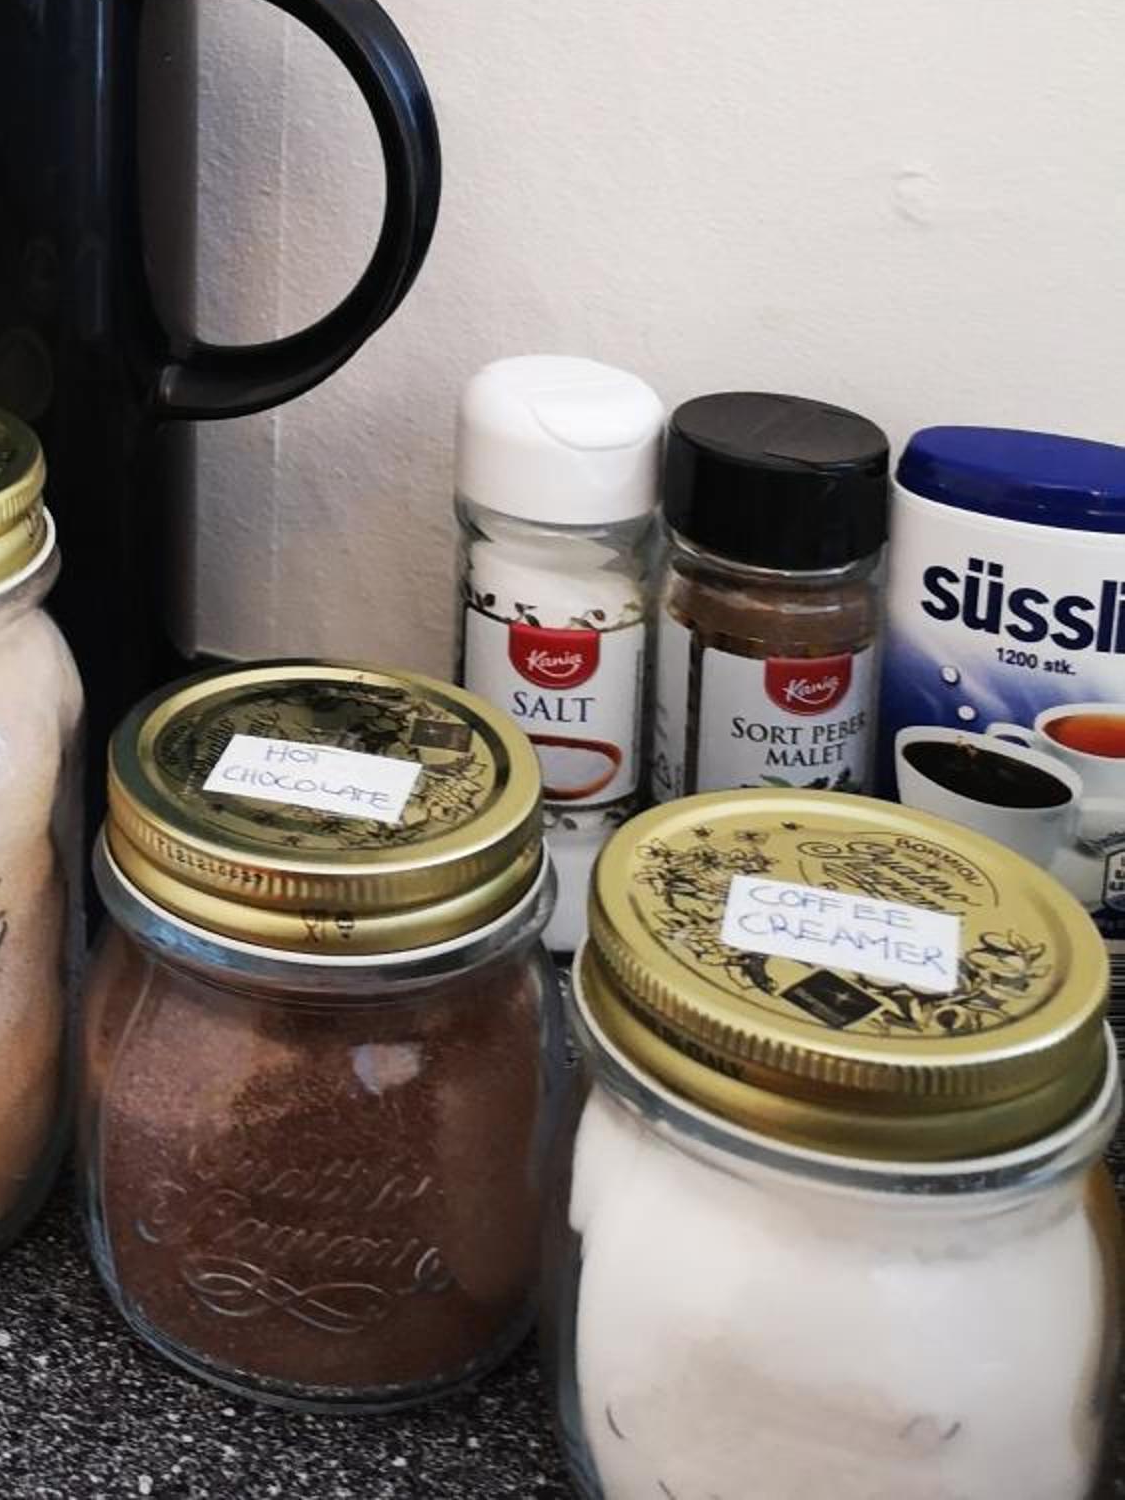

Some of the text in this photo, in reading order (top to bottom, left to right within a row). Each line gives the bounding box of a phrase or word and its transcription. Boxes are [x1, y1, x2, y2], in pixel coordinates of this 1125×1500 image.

[995, 647, 1077, 677] 1200 stk.
[511, 690, 596, 723] SALT
[731, 716, 804, 745] SORT
[264, 744, 345, 765] HOT
[765, 741, 845, 767] MALET
[222, 764, 396, 811] CHOCOLATE
[748, 885, 915, 930] COFFEE
[737, 911, 948, 976] CREAMER
